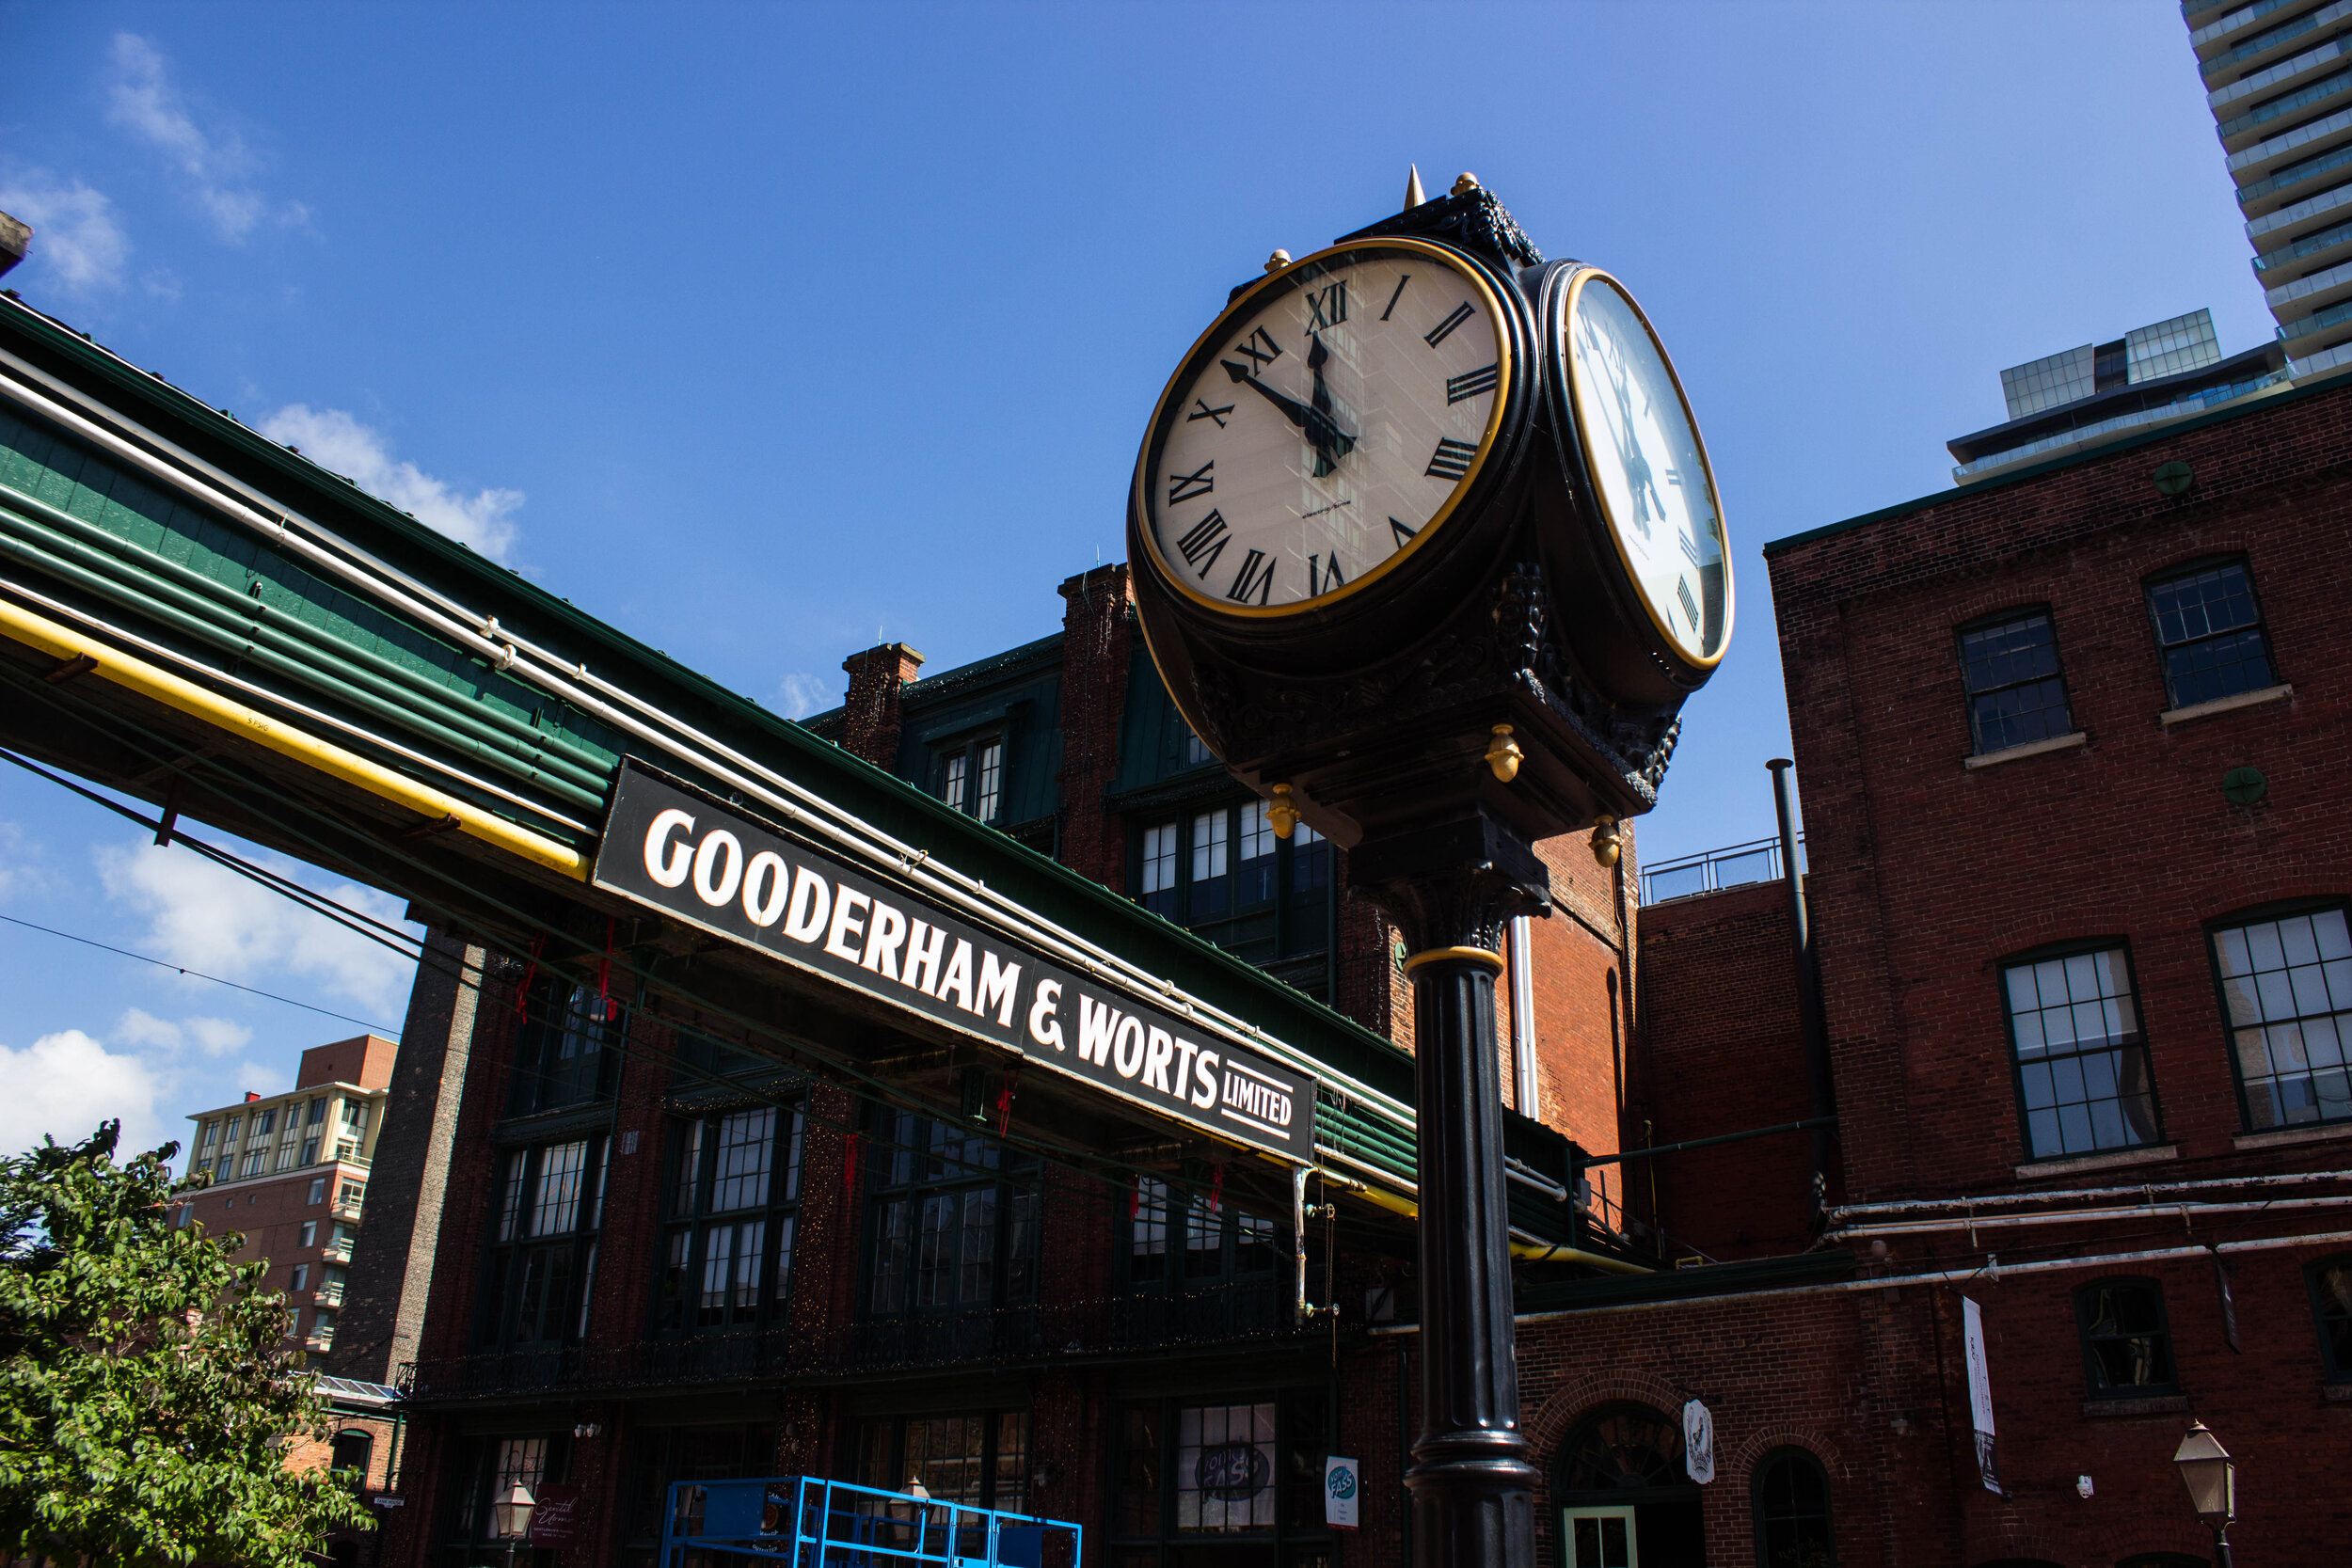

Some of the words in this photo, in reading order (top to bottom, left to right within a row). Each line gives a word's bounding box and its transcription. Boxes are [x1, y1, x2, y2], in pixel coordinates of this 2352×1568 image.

[1305, 279, 1348, 336] XII
[1423, 301, 1476, 349] II
[1234, 325, 1283, 376] XI
[1446, 362, 1499, 406] III
[1186, 399, 1235, 429] X
[1169, 460, 1214, 507] IX
[1176, 508, 1232, 580] VIII
[1227, 548, 1278, 606] VII
[644, 807, 1022, 1029] GOODERHAM
[1028, 979, 1066, 1052] &
[1077, 994, 1221, 1110] WORTS
[1223, 1070, 1292, 1129] LIMITED
[1331, 1474, 1353, 1498] FASS
